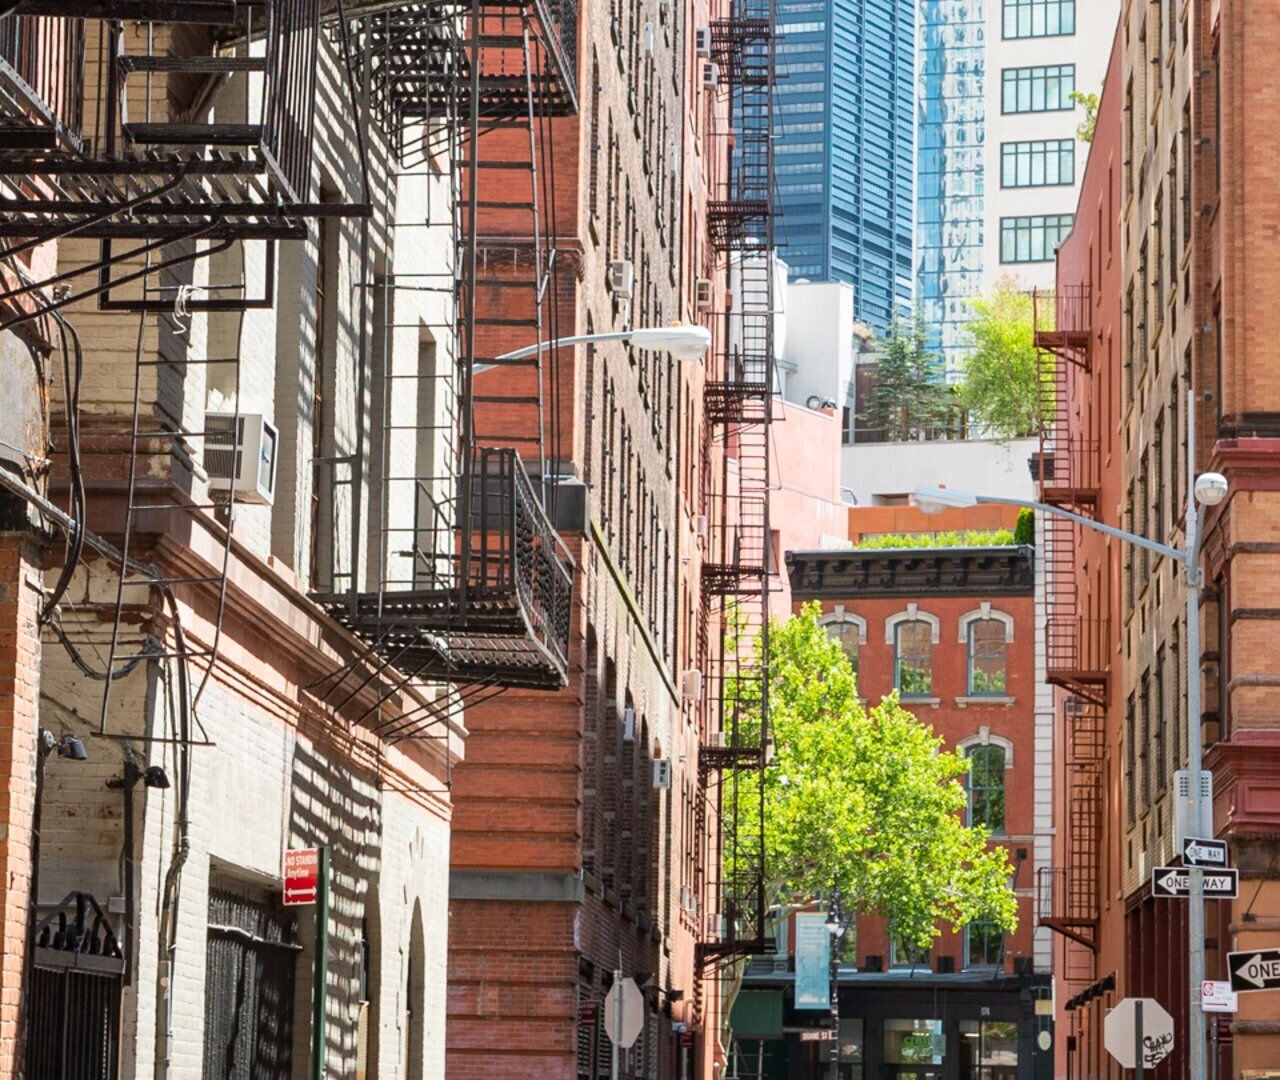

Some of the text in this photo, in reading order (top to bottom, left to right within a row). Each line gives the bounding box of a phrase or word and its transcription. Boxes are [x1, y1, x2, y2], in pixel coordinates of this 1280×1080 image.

[1190, 847, 1221, 859] ONE WAY
[1166, 877, 1189, 888] ONE
[1248, 962, 1280, 979] ONE
